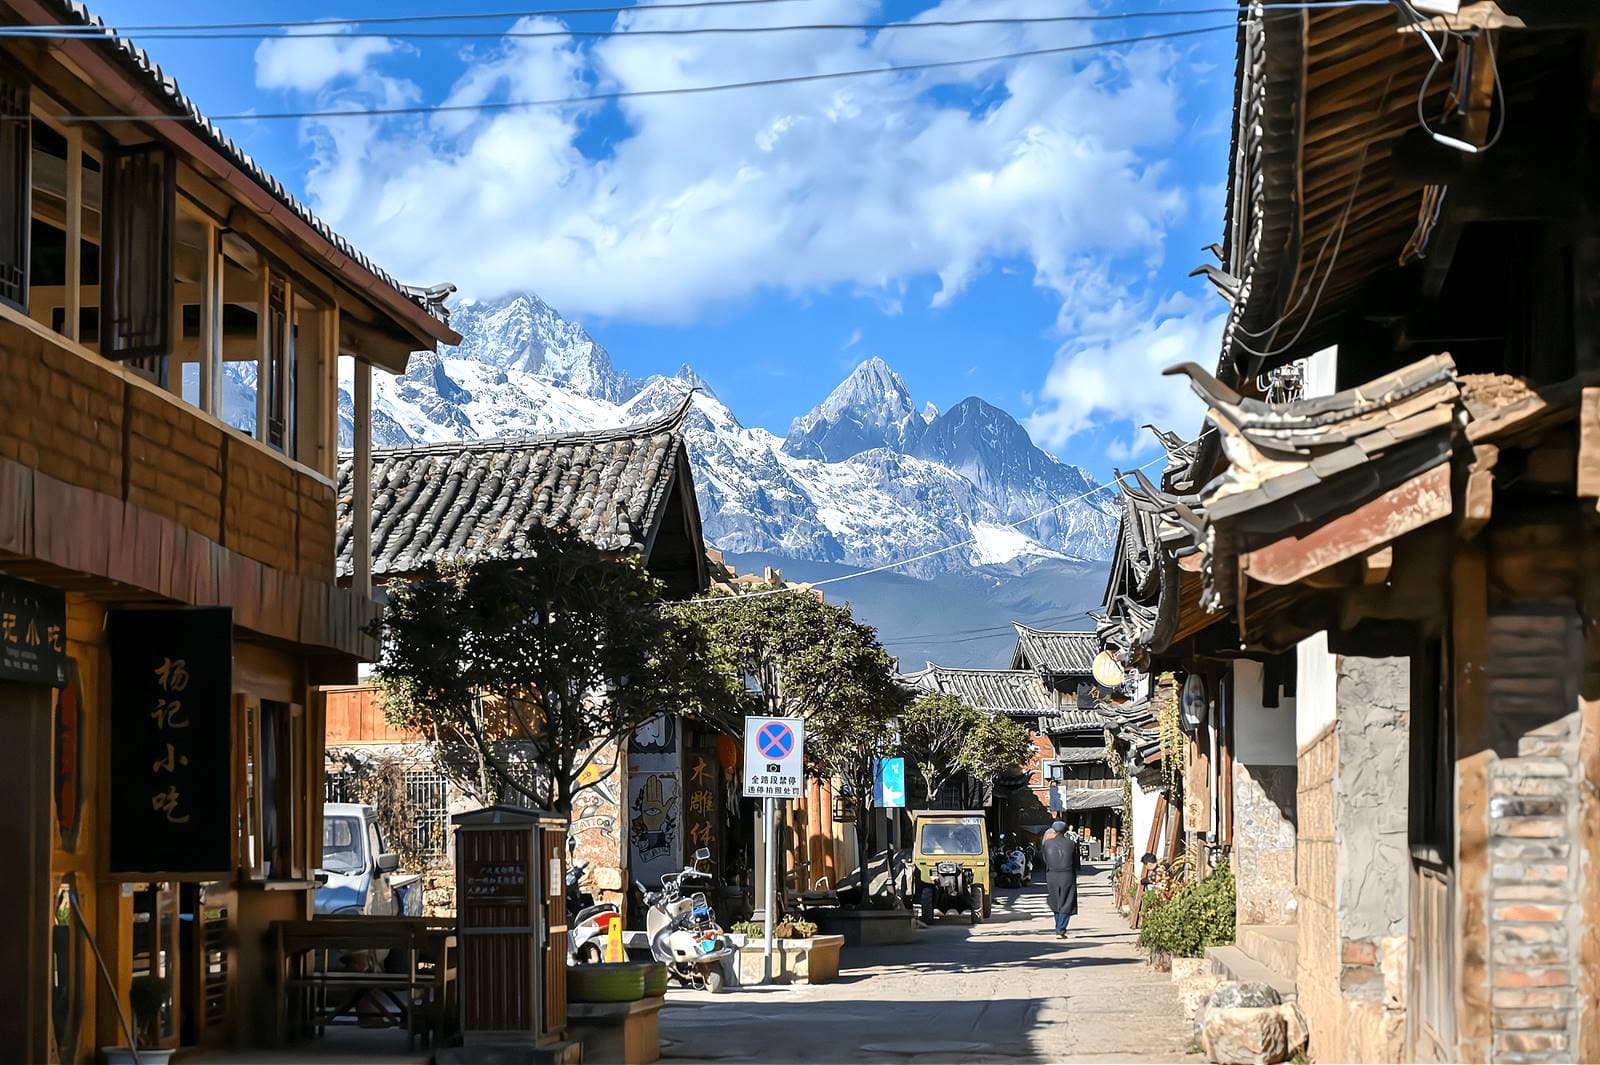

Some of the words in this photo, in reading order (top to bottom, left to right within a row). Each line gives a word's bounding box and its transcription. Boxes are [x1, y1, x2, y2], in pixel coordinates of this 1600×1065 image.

[152, 657, 190, 823] 杨记小吃
[751, 775, 796, 785] 全路段禁停
